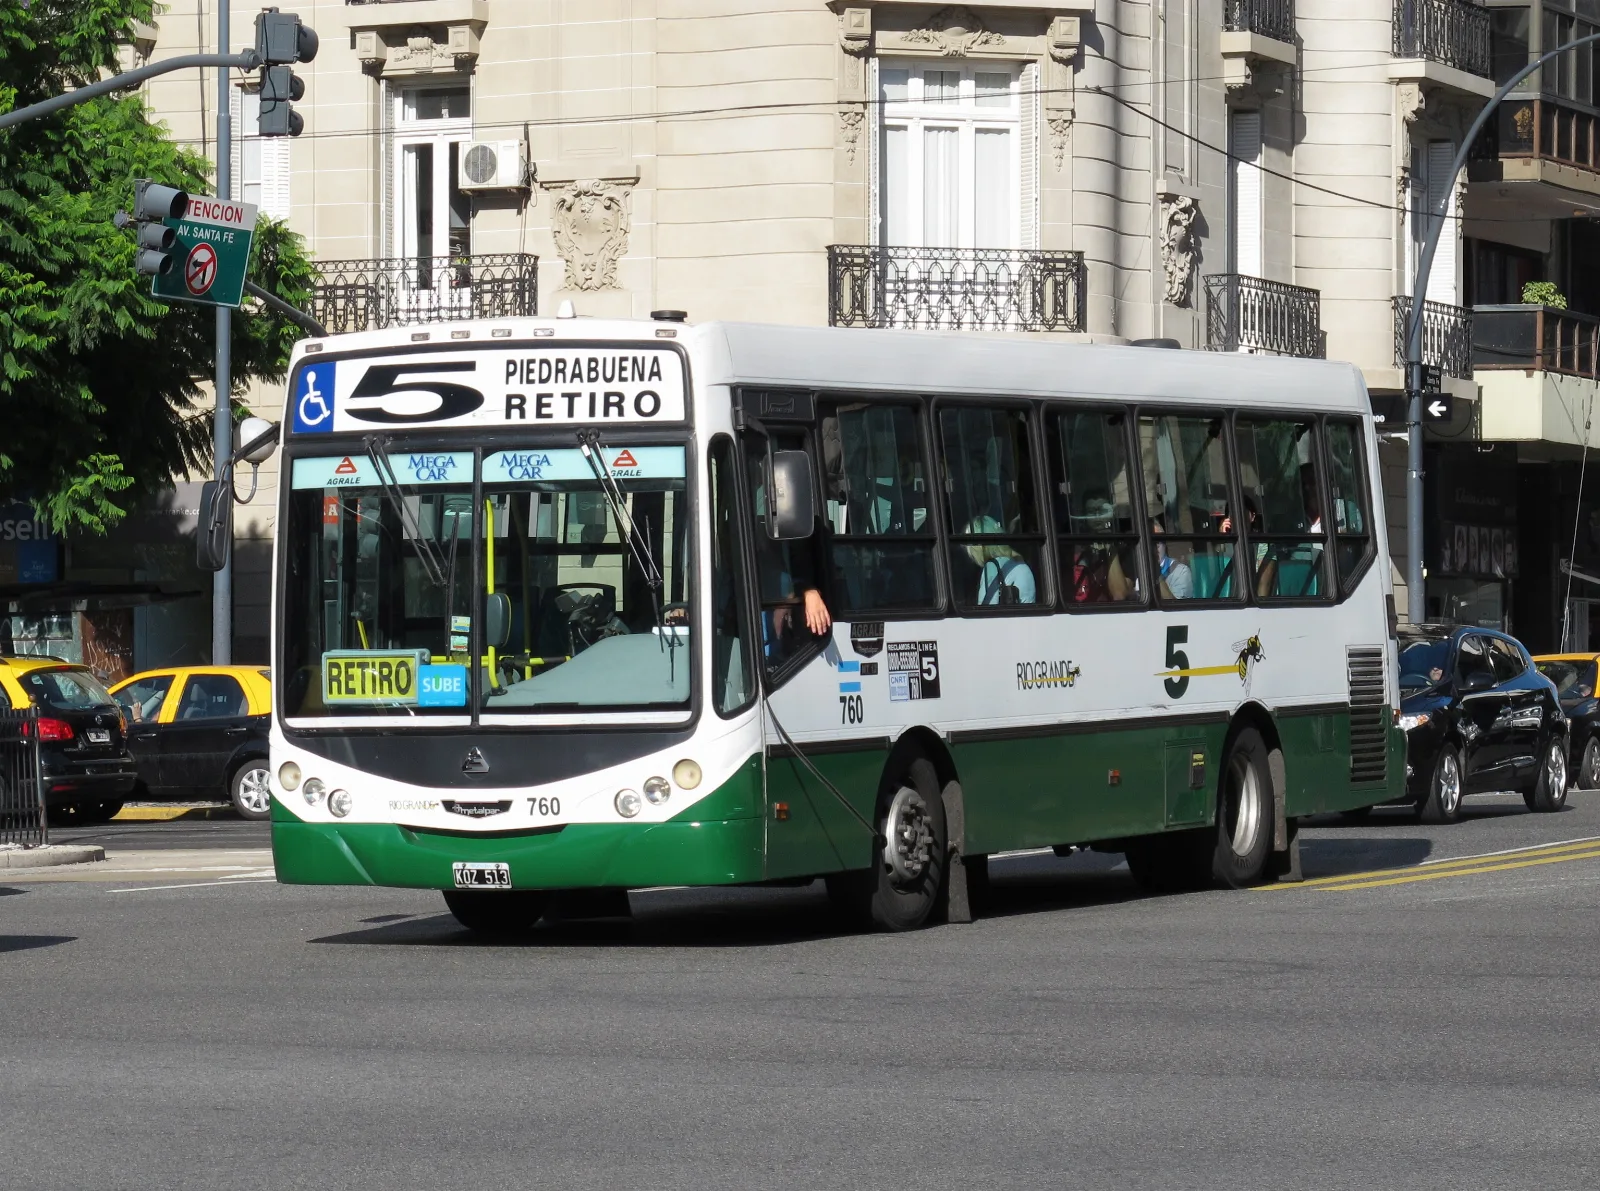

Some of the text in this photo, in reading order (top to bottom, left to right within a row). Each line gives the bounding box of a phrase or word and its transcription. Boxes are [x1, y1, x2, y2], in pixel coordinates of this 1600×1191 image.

[187, 199, 244, 223] TENCION
[177, 224, 235, 244] AV. SANTA FE
[505, 356, 662, 385] PIEDRABUENA
[344, 360, 484, 424] 5
[505, 390, 662, 420] RETIRO
[408, 454, 458, 469] MEGA
[500, 452, 553, 468] MEGA
[326, 476, 361, 486] AGRALE
[415, 467, 450, 481] CAR
[508, 465, 544, 480] CAR
[0, 518, 49, 541] sell
[851, 623, 884, 637] AGRALE
[918, 643, 938, 651] LINEA
[922, 657, 937, 681] 5
[1163, 624, 1190, 700] 5
[327, 659, 412, 696] RETIRO
[422, 675, 462, 692] SUBE
[891, 676, 906, 684] CNRT
[1016, 660, 1074, 690] RIO GRANDE
[840, 694, 864, 724] 760
[460, 806, 501, 817] metalpar
[526, 797, 561, 816] 760
[455, 869, 509, 885] KOZ 513
